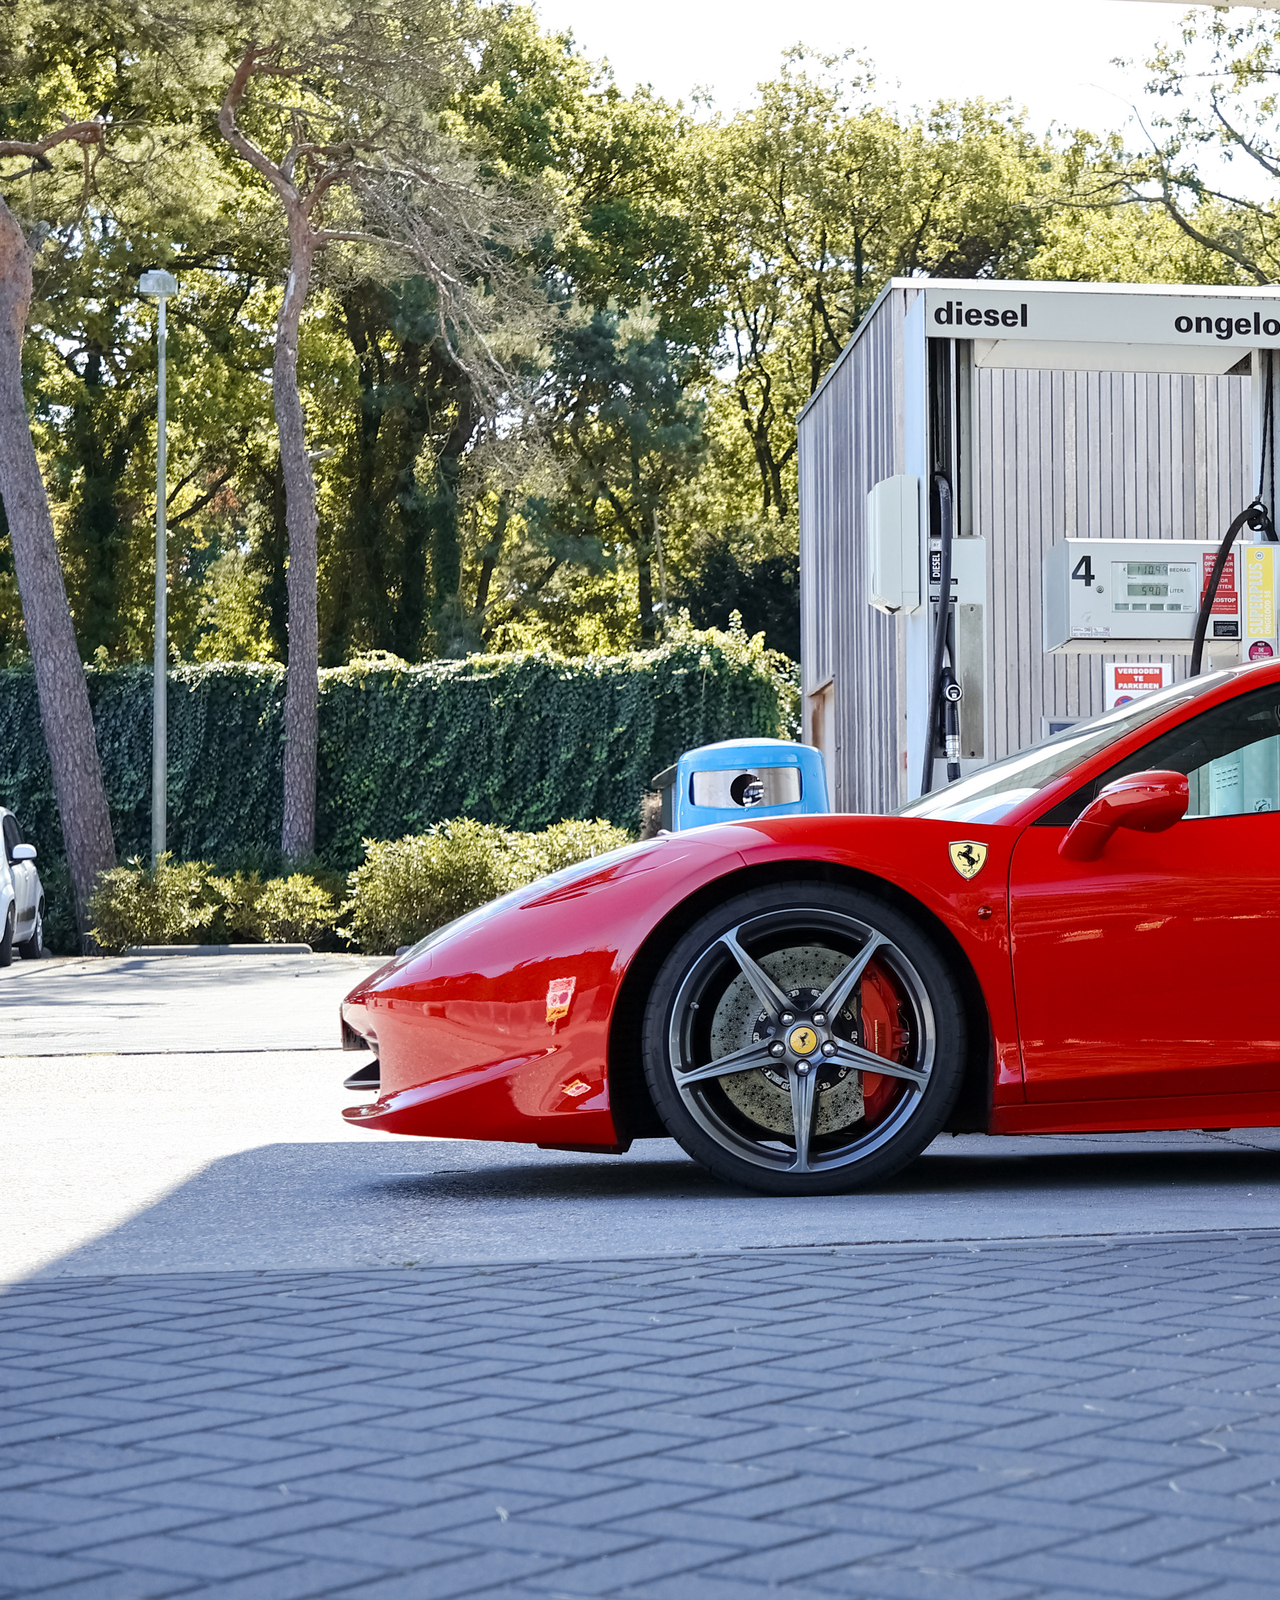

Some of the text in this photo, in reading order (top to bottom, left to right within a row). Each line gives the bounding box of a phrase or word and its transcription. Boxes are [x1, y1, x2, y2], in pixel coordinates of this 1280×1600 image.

[933, 301, 1029, 328] diesel
[932, 553, 941, 578] DIESEL
[1071, 555, 1095, 587] 4
[1249, 563, 1263, 634] SUPERPLUS
